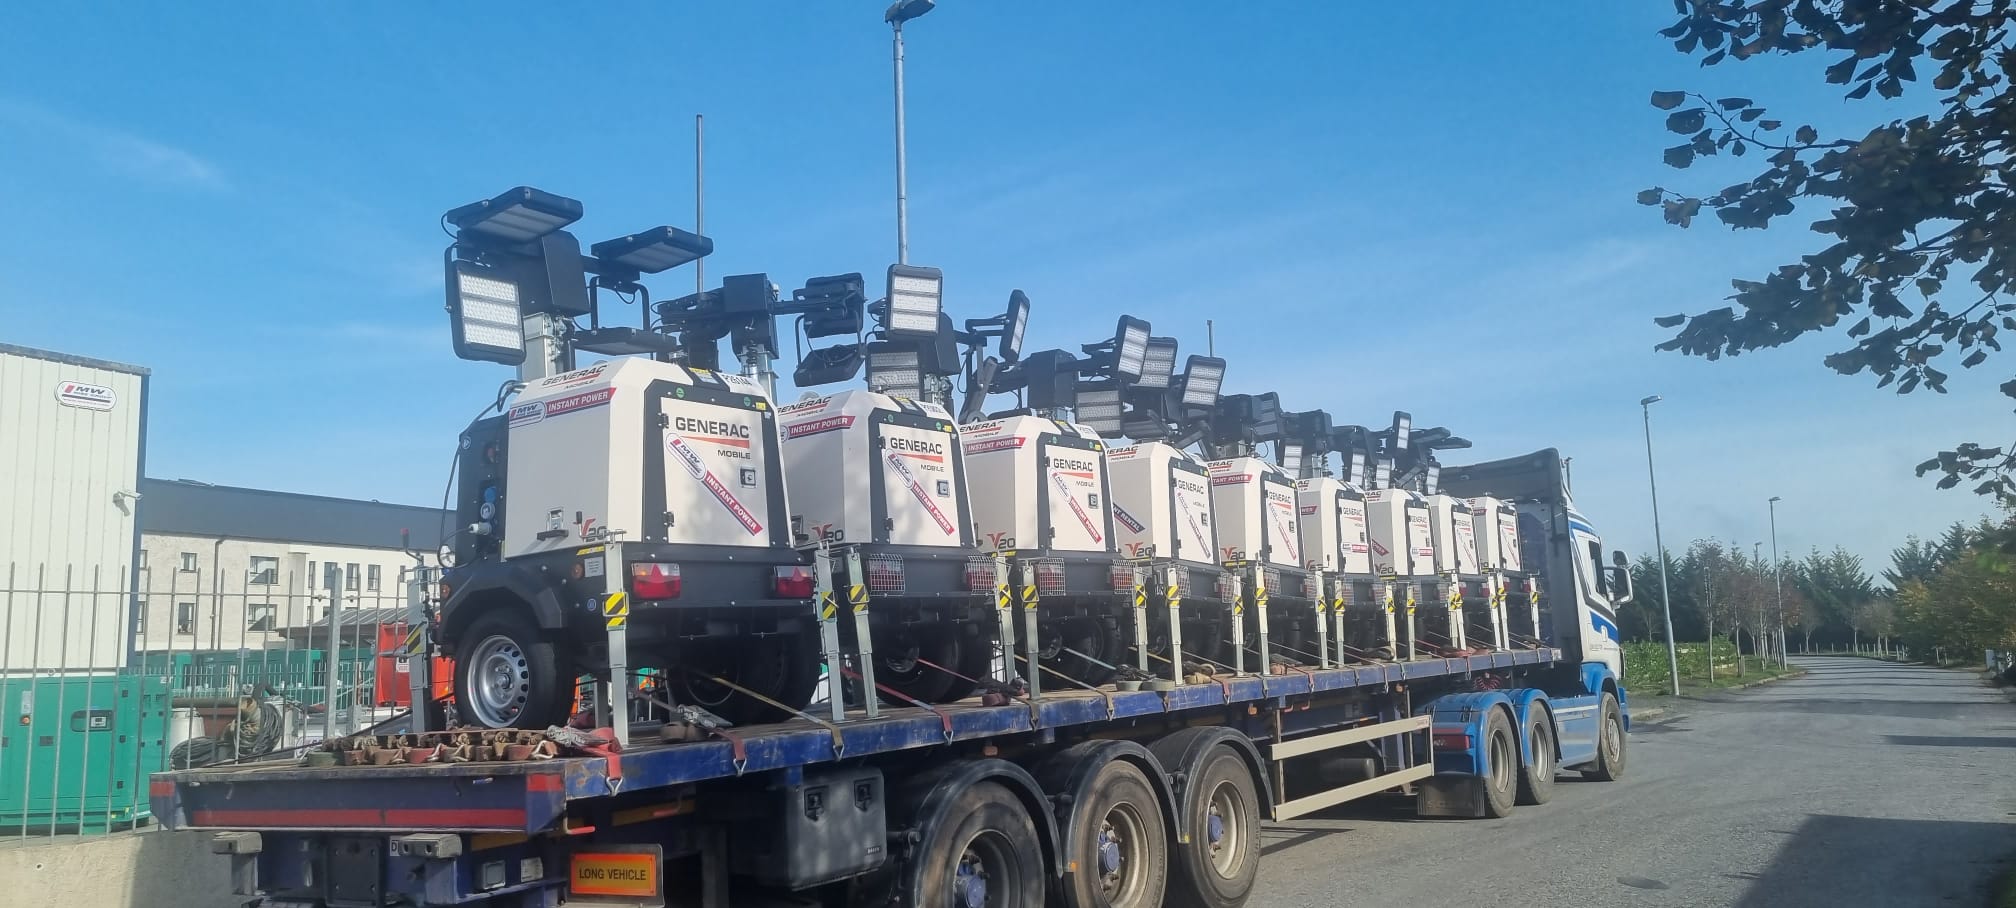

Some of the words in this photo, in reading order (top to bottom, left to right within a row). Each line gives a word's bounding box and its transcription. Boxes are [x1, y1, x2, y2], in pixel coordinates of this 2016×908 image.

[542, 365, 608, 386] GENERAC
[548, 399, 580, 412] INSTANT
[581, 391, 609, 404] POWER
[675, 416, 750, 438] GENERAC
[791, 422, 821, 434] INSTANT
[821, 417, 849, 428] POWER
[890, 437, 943, 455] GENERAC
[968, 442, 995, 452] INSTANT
[995, 438, 1020, 448] POWER
[717, 449, 751, 460] MOBILE
[920, 464, 945, 473] MOBILE
[1053, 458, 1093, 472] GENERAC
[1178, 480, 1204, 494] GENERAC
[706, 475, 736, 507] INSTANT
[733, 504, 758, 531] POWER
[1269, 491, 1291, 504] GENERAC
[913, 483, 935, 511] INSTANT
[934, 507, 952, 531] POWER
[1120, 513, 1141, 532] RENTAL
[986, 531, 1016, 550] V20
[1125, 542, 1152, 558] V20
[1220, 547, 1246, 560] V20
[578, 868, 605, 880] LONG
[607, 868, 646, 881] VEHICLE
